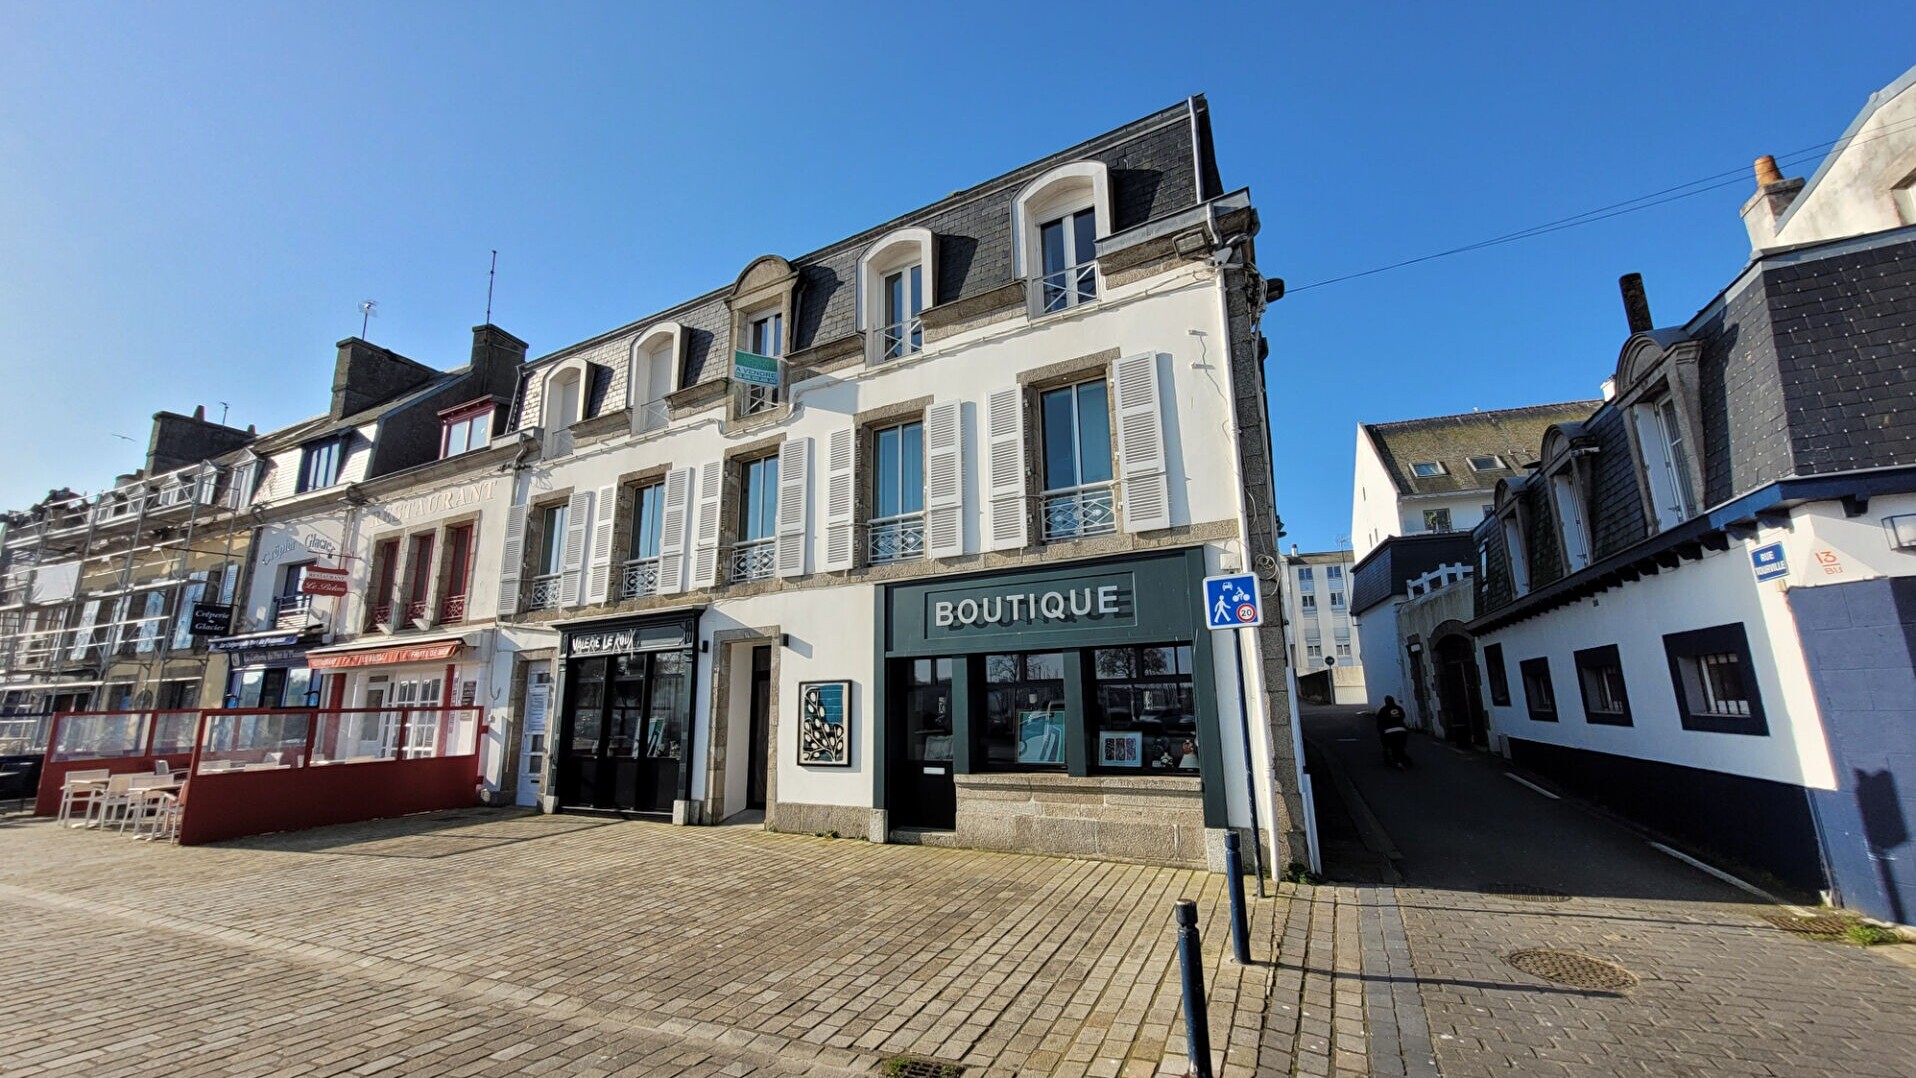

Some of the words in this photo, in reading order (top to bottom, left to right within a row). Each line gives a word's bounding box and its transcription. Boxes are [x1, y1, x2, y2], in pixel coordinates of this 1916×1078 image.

[369, 480, 498, 528] RESTAURANT
[1760, 551, 1775, 562] RUE
[1815, 551, 1838, 564] 13
[1756, 561, 1786, 576] TOURVILLE
[935, 585, 1120, 627] BOUTIQUE
[195, 610, 231, 619] Crêperie
[1241, 609, 1252, 617] 20
[195, 622, 226, 631] Glacier
